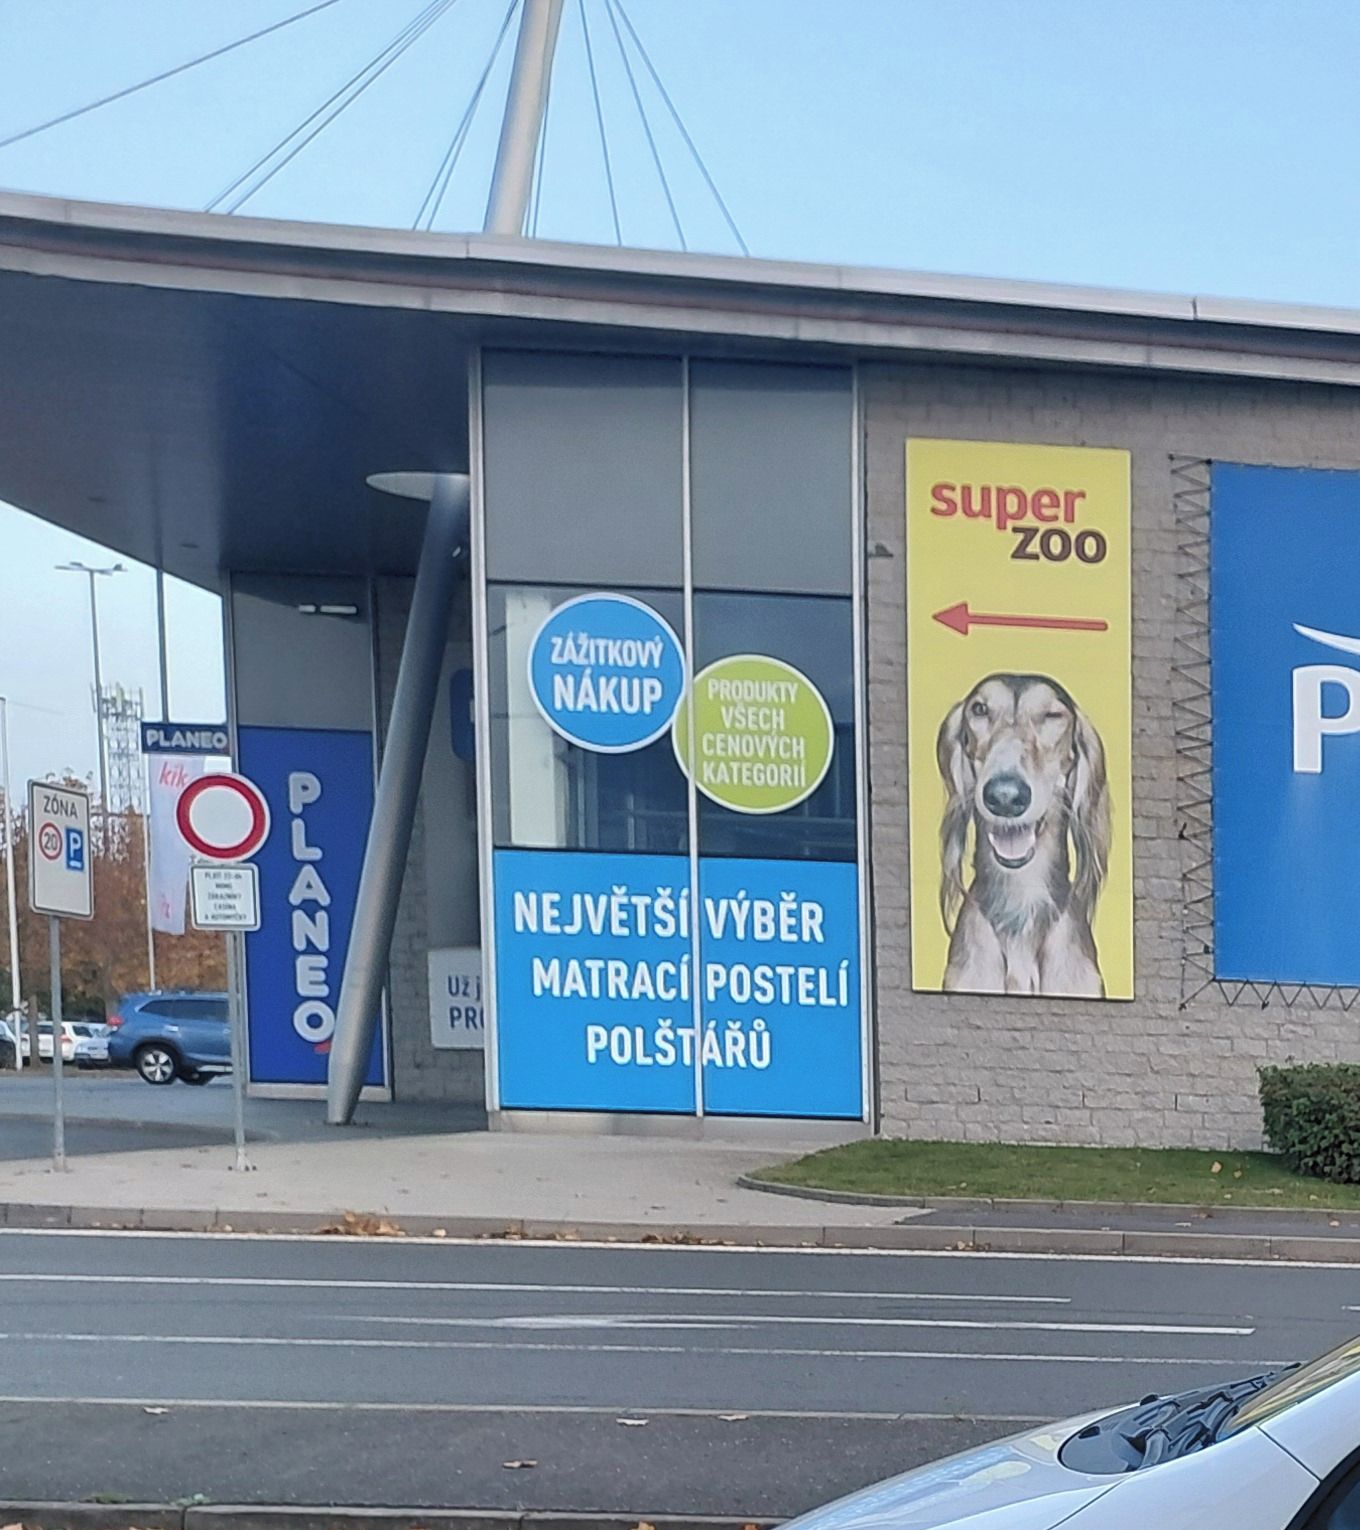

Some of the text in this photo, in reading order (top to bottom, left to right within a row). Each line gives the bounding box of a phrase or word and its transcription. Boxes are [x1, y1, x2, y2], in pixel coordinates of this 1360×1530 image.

[930, 481, 1087, 532] super
[1009, 525, 1108, 565] zoo
[551, 630, 664, 669] ZÁŽITKOVÝ
[553, 669, 663, 715] NÁKUP
[707, 678, 799, 704] PRODUKTY
[721, 704, 785, 731] VŠECH
[145, 728, 228, 749] PLANEO
[702, 730, 806, 759] CENOVÝCH
[702, 760, 807, 788] KATEGORIÍ
[43, 794, 79, 820] ZÓNA
[43, 832, 58, 852] 20
[288, 770, 336, 1044] PLANEO
[513, 885, 825, 943] NEJVĚTŠÍ VÝBĚR
[532, 953, 850, 1008] MATRACÍ POSTELÍ
[586, 1017, 772, 1070] POLŠTÁŘŮ
